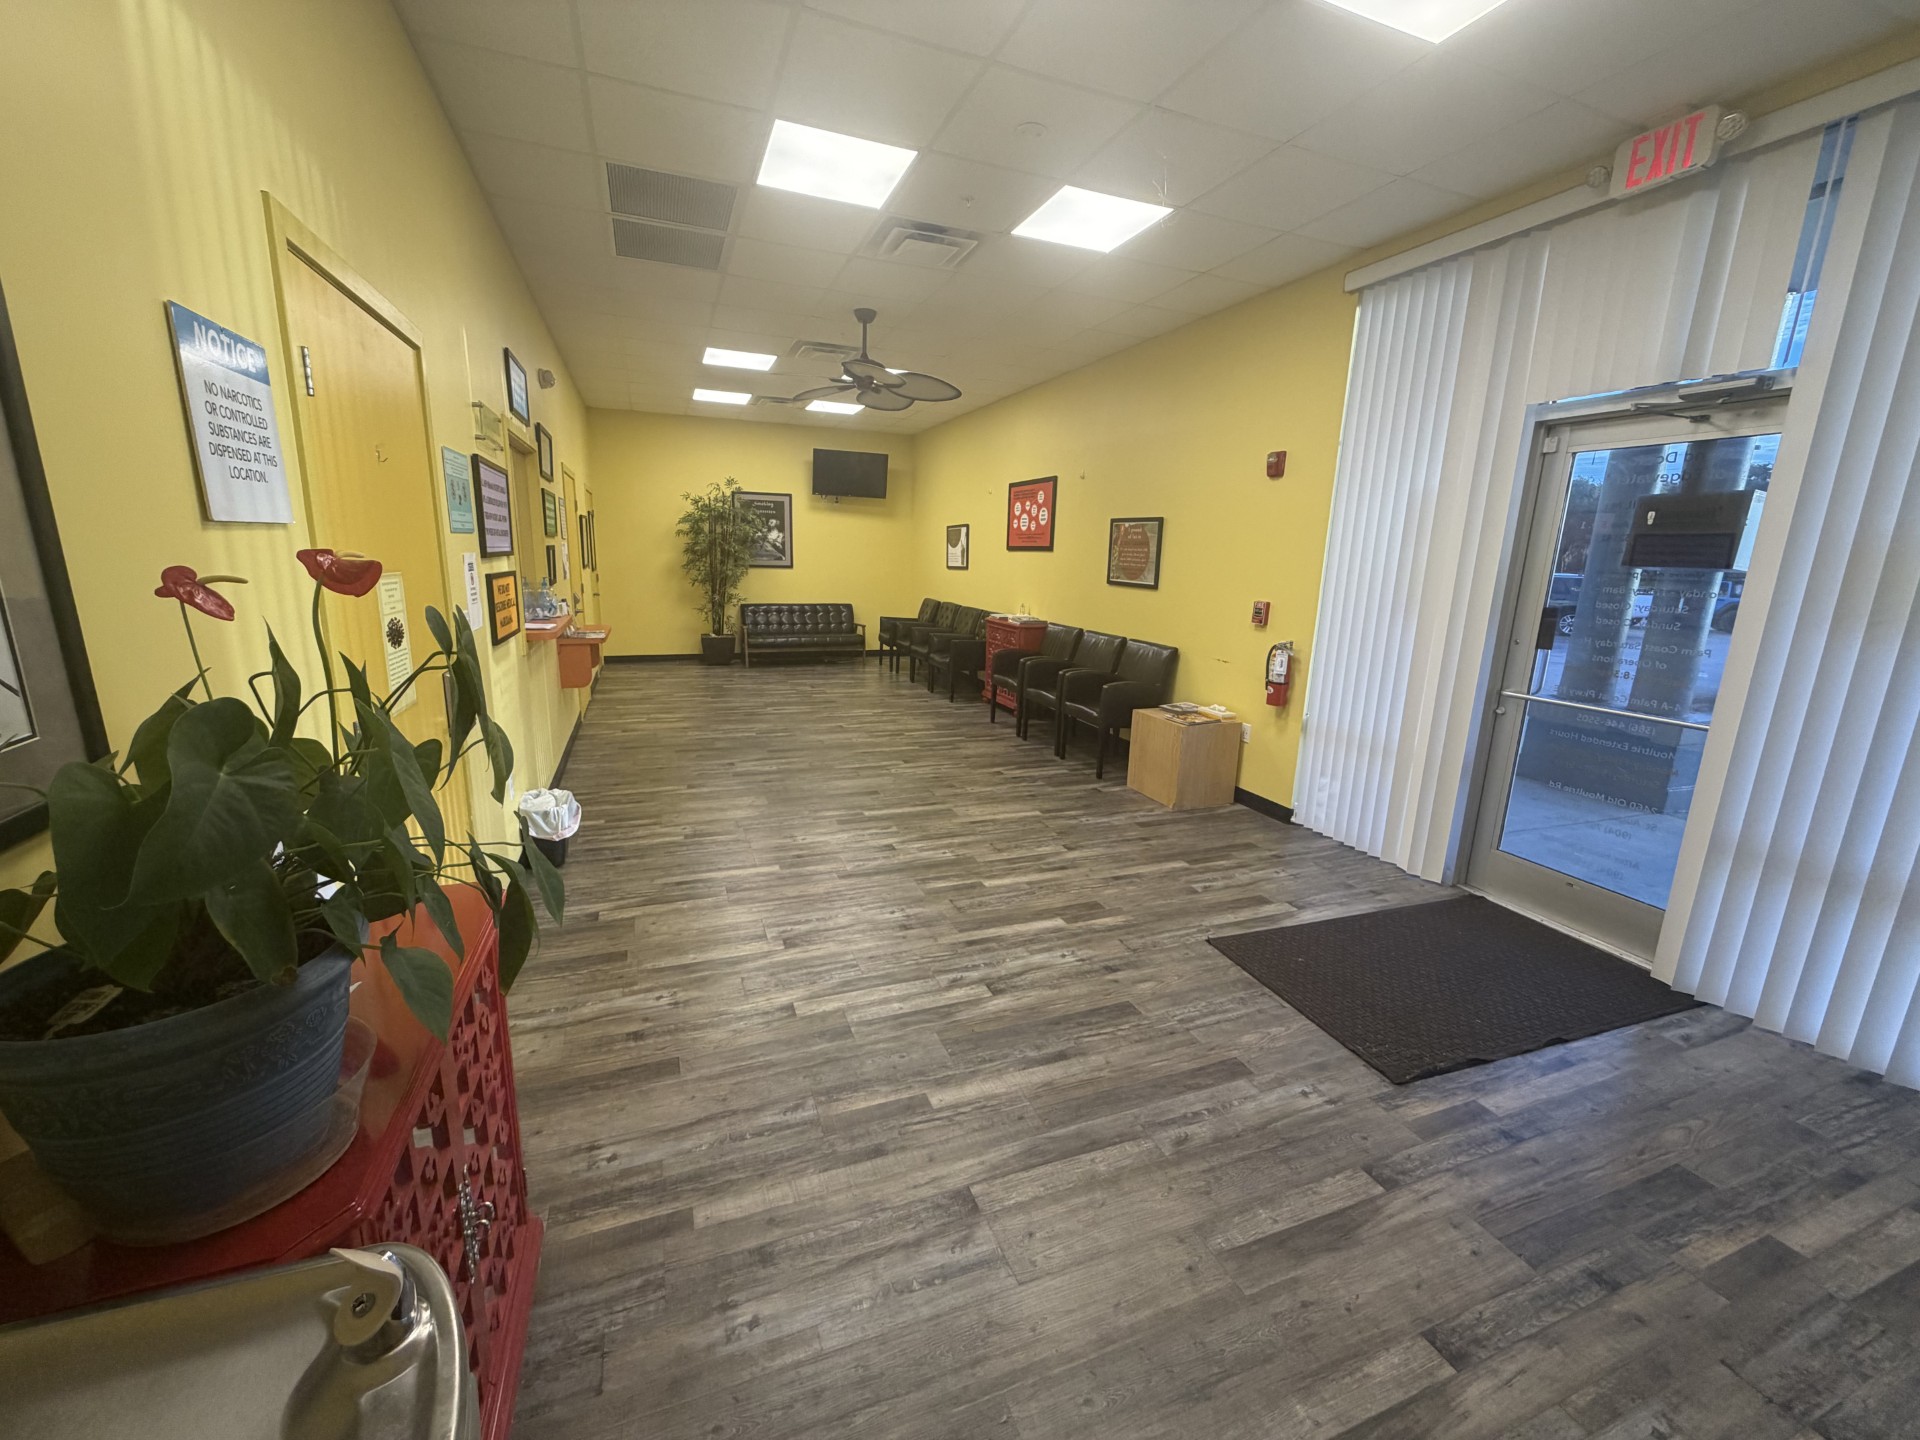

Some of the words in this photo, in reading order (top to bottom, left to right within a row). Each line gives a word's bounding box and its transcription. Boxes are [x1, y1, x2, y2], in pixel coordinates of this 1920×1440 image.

[1625, 111, 1706, 190] EXIT
[193, 321, 257, 373] NOTICE
[203, 379, 219, 397] NO
[219, 385, 263, 411] NARCOTICS
[204, 400, 219, 416] OR
[219, 404, 268, 430] CONTROLLED
[208, 421, 258, 446] SUBSTANCES
[258, 434, 272, 449] ARE
[208, 442, 252, 462] DISPENSED
[253, 453, 262, 465] AT
[262, 455, 278, 468] THIS
[228, 465, 269, 483] LOCATION.
